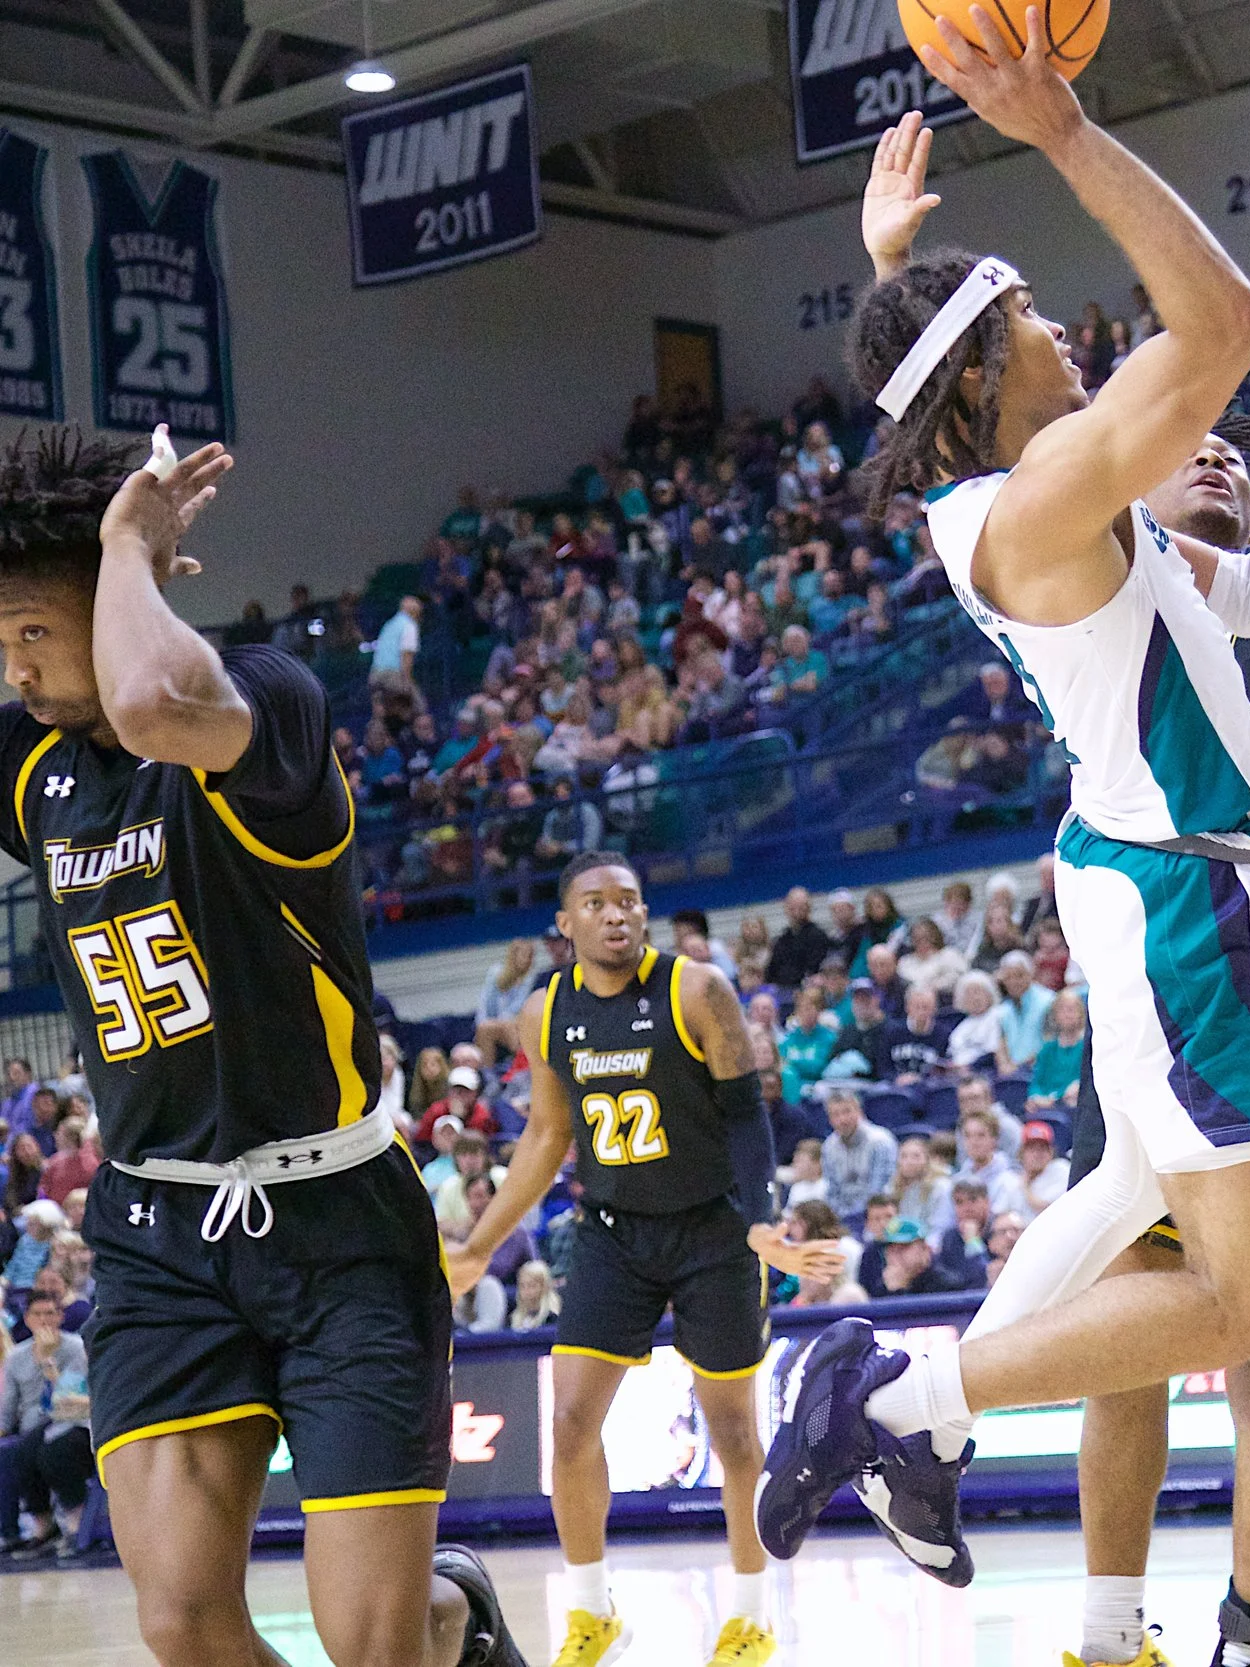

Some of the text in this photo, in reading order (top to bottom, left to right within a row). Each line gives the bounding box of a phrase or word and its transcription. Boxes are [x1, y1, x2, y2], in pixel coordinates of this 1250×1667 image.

[359, 90, 525, 205] WNIT
[415, 190, 493, 253] 2011
[113, 296, 211, 396] 25
[799, 283, 855, 328] 215
[68, 900, 214, 1063] 55
[581, 1088, 670, 1167] 22
